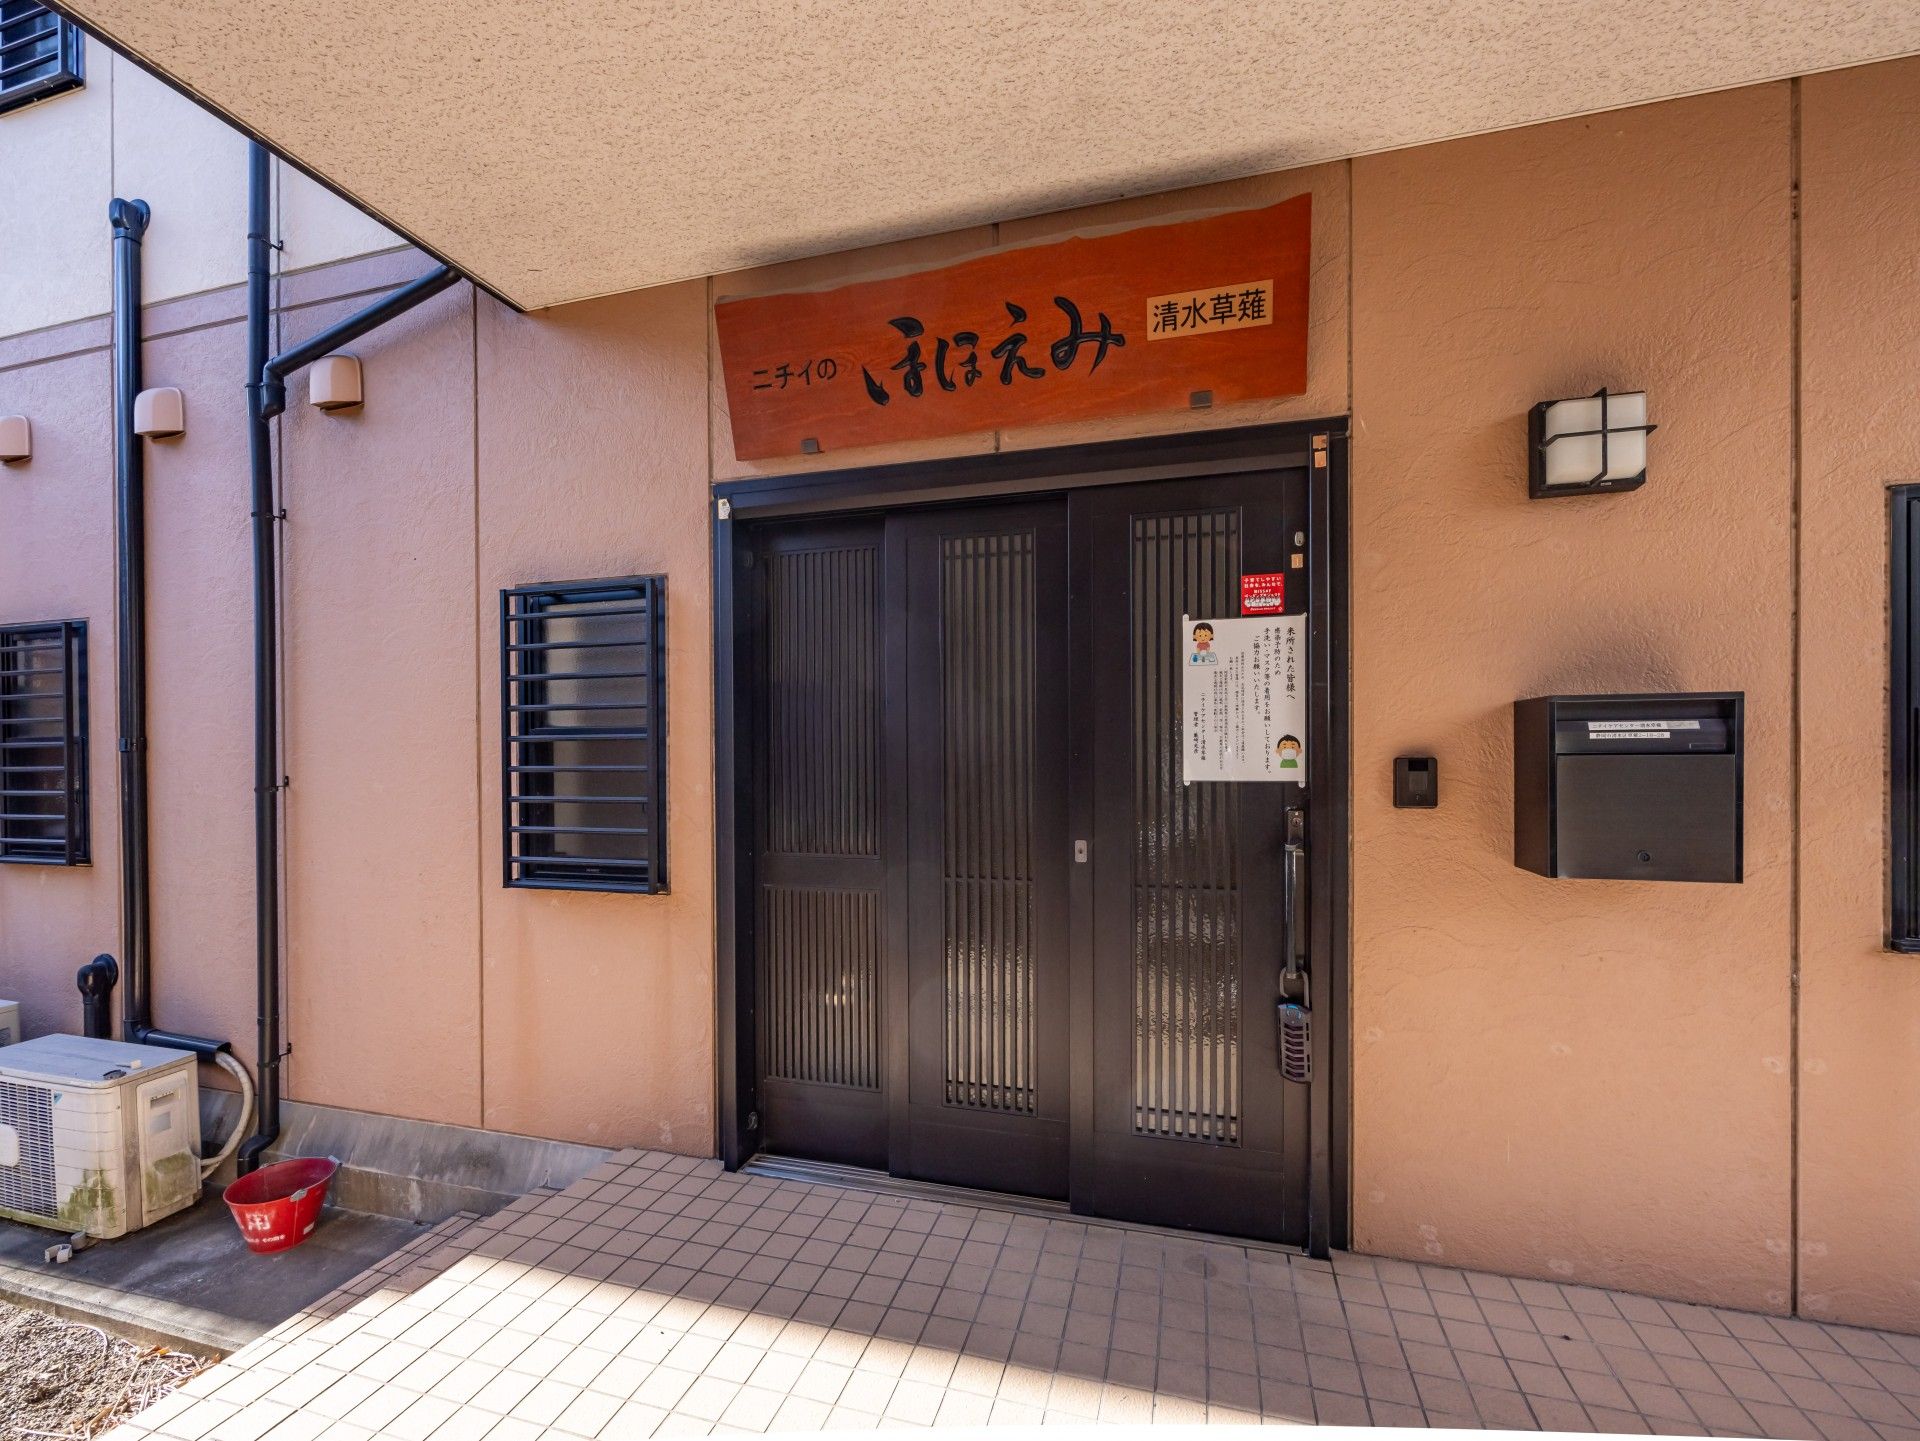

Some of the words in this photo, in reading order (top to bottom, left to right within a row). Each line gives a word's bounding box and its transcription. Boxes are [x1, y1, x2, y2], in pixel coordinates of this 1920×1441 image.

[1152, 288, 1267, 333] 清水草薙
[752, 357, 837, 391] ニチイの
[862, 296, 1126, 406] ほほえみ
[1286, 626, 1296, 700] 来所された皆様へ
